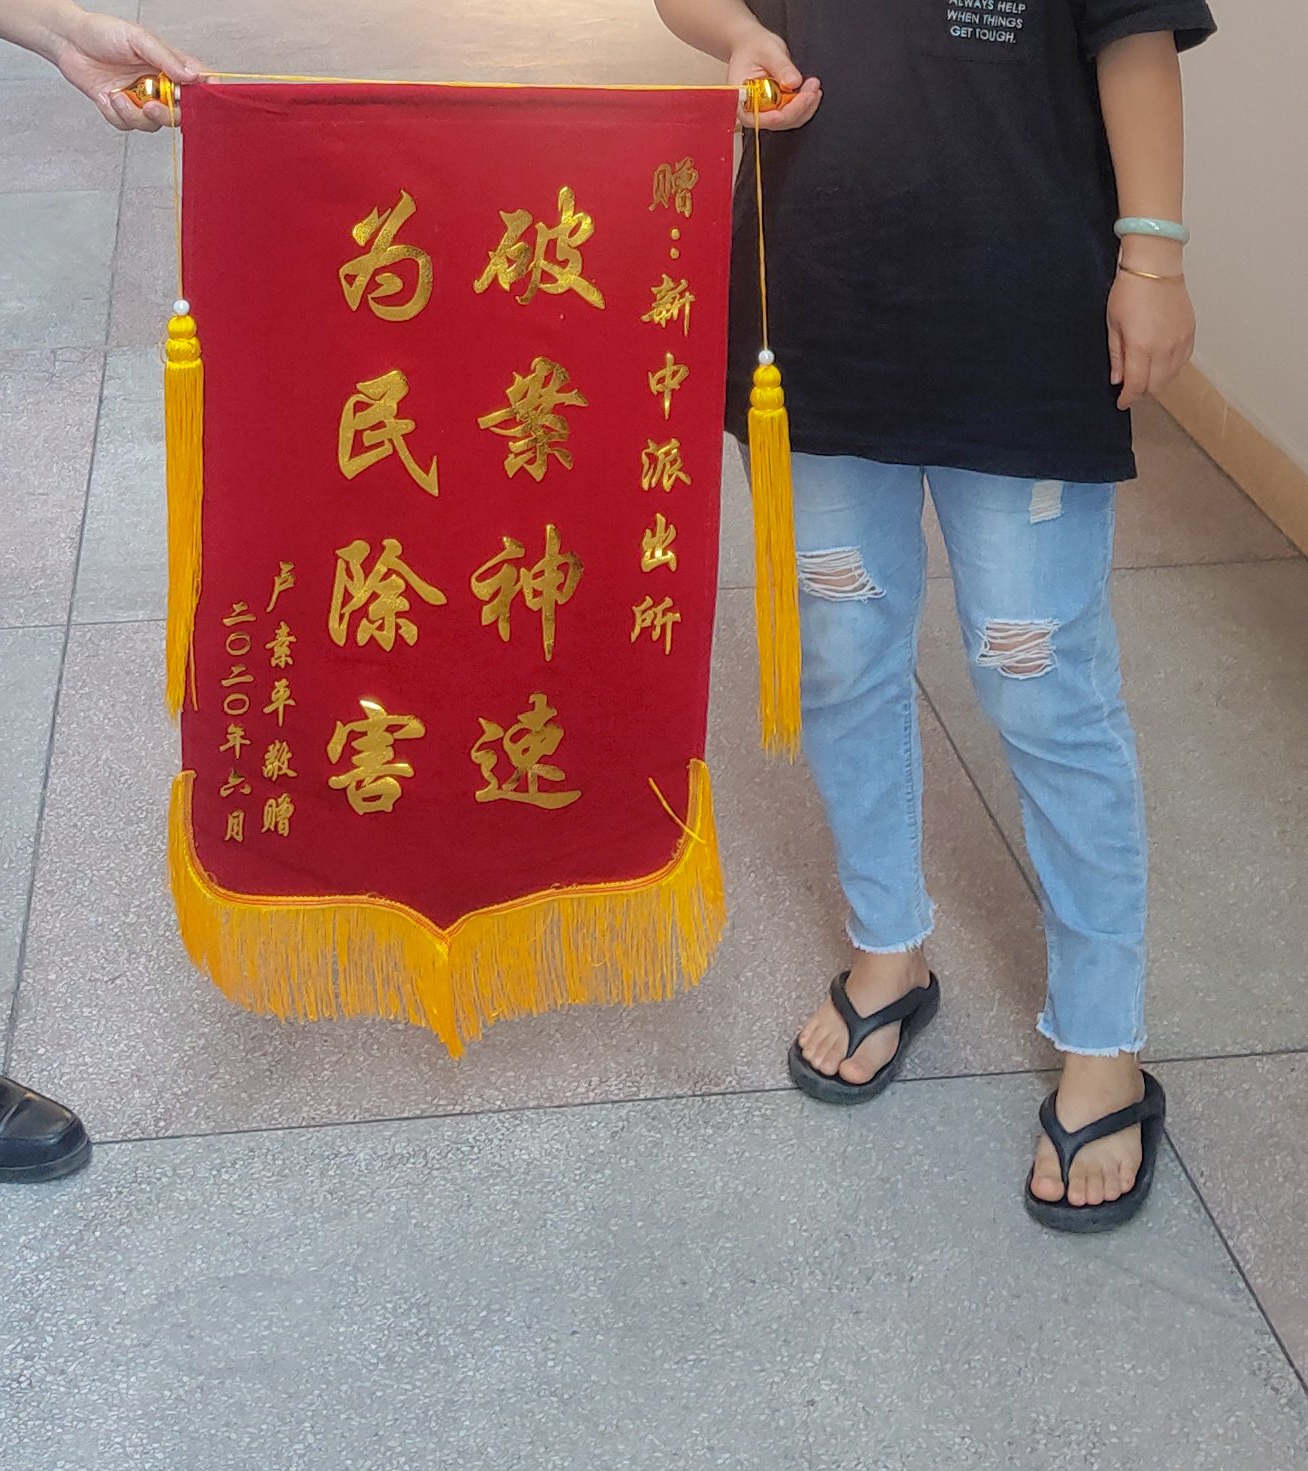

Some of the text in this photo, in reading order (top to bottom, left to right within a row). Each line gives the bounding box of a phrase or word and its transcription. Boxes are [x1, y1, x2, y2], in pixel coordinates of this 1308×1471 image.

[947, 9, 1023, 29] WHEN THINGS
[950, 26, 1016, 43] GET TOUGH.
[997, 1, 1026, 14] HELP
[327, 188, 447, 816] 为民除害
[471, 186, 606, 811] 破案神速
[630, 155, 699, 655] 赠：新中派出所
[261, 560, 298, 838] 卢素平敬赠
